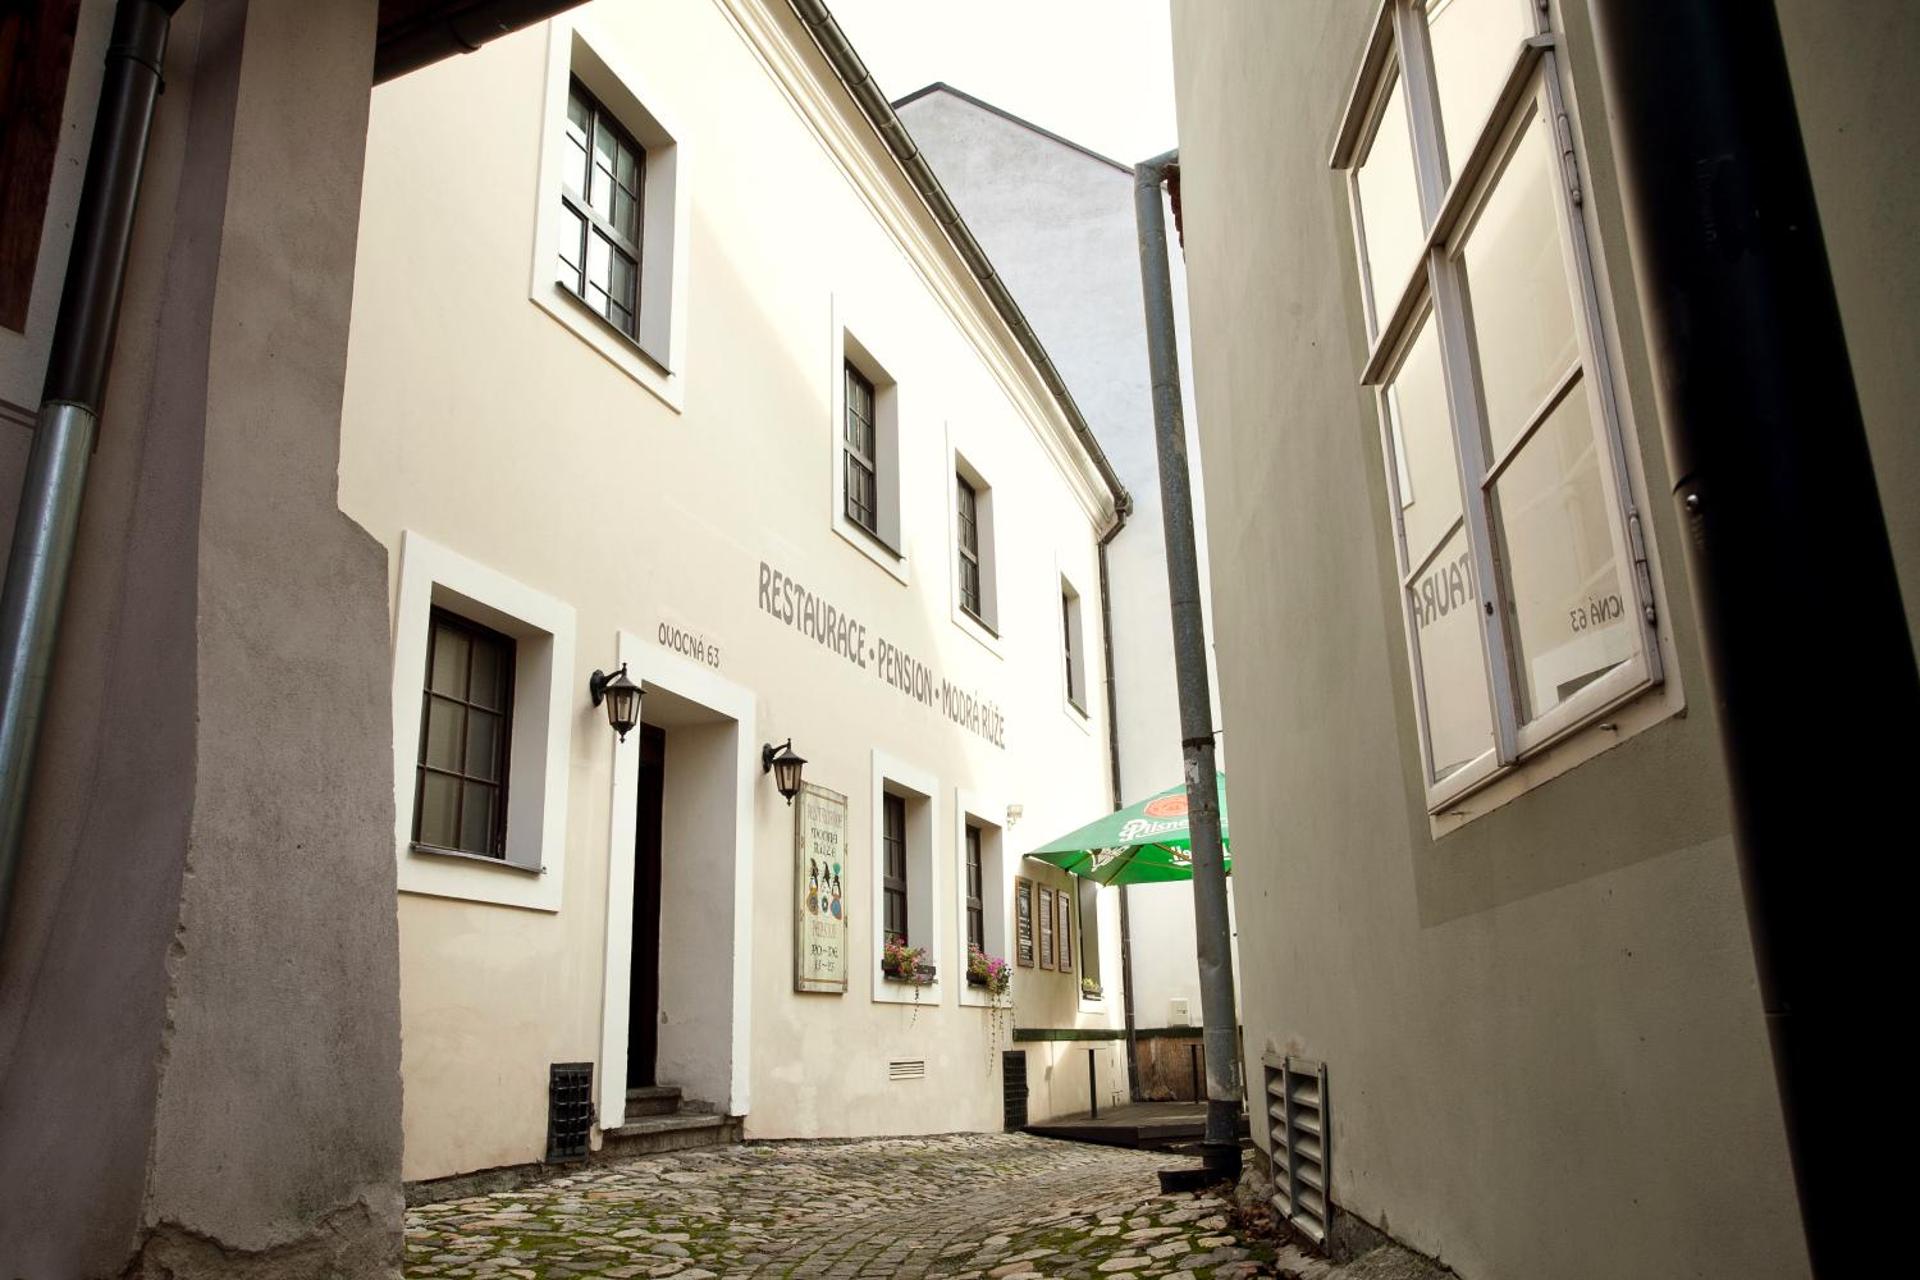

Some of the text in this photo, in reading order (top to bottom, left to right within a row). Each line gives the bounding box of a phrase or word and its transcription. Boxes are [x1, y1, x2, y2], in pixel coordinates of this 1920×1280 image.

[658, 622, 719, 668] OVOCNÁ 63
[759, 561, 866, 669] RESTAURACE
[878, 638, 932, 707] PENSION
[942, 678, 980, 736] MODRÁ
[1119, 819, 1190, 843] Pilsne
